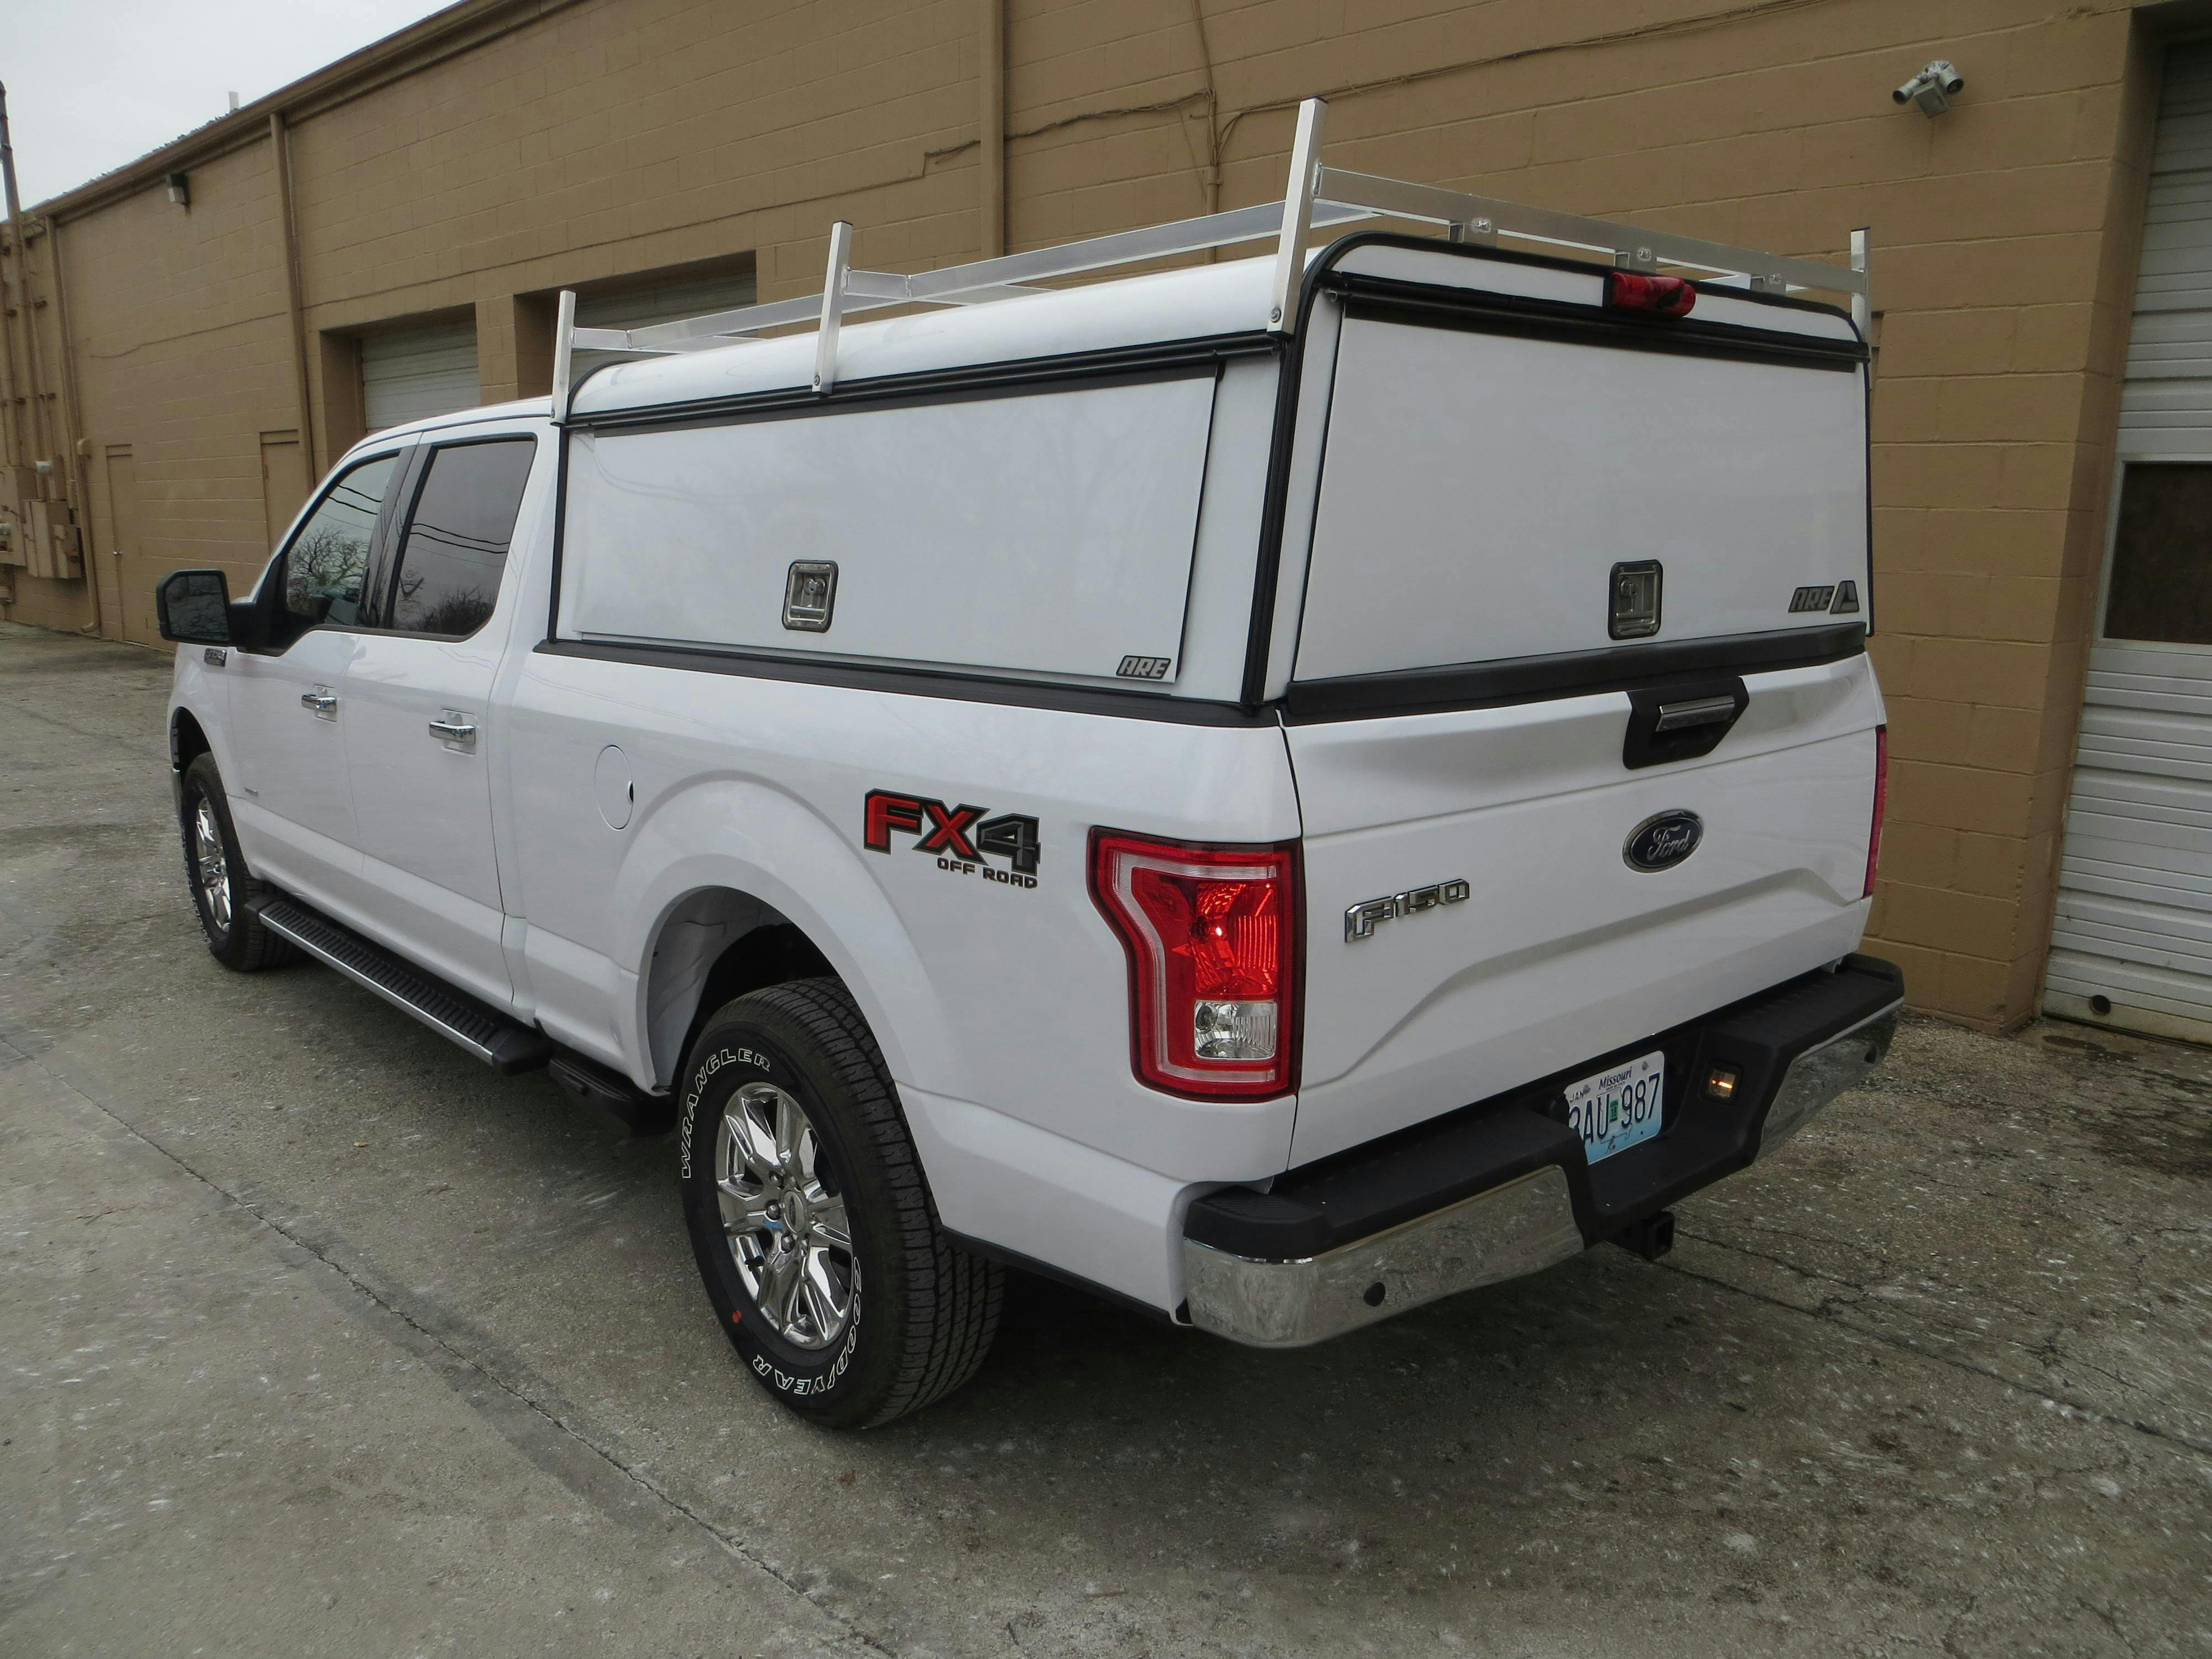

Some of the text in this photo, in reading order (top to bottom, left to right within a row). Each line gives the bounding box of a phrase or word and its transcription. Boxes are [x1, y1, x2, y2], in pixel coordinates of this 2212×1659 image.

[1116, 656, 1171, 679] ARE
[864, 788, 1041, 876] FX4
[1646, 824, 1691, 861] Ford
[937, 857, 1038, 889] OFF ROAD
[1570, 1091, 1584, 1102] JAN
[1599, 1066, 1632, 1090] Missouri
[681, 1048, 770, 1178] WRANGLER
[1621, 1072, 1660, 1128] 987
[753, 1256, 862, 1395] GOODYEAR
